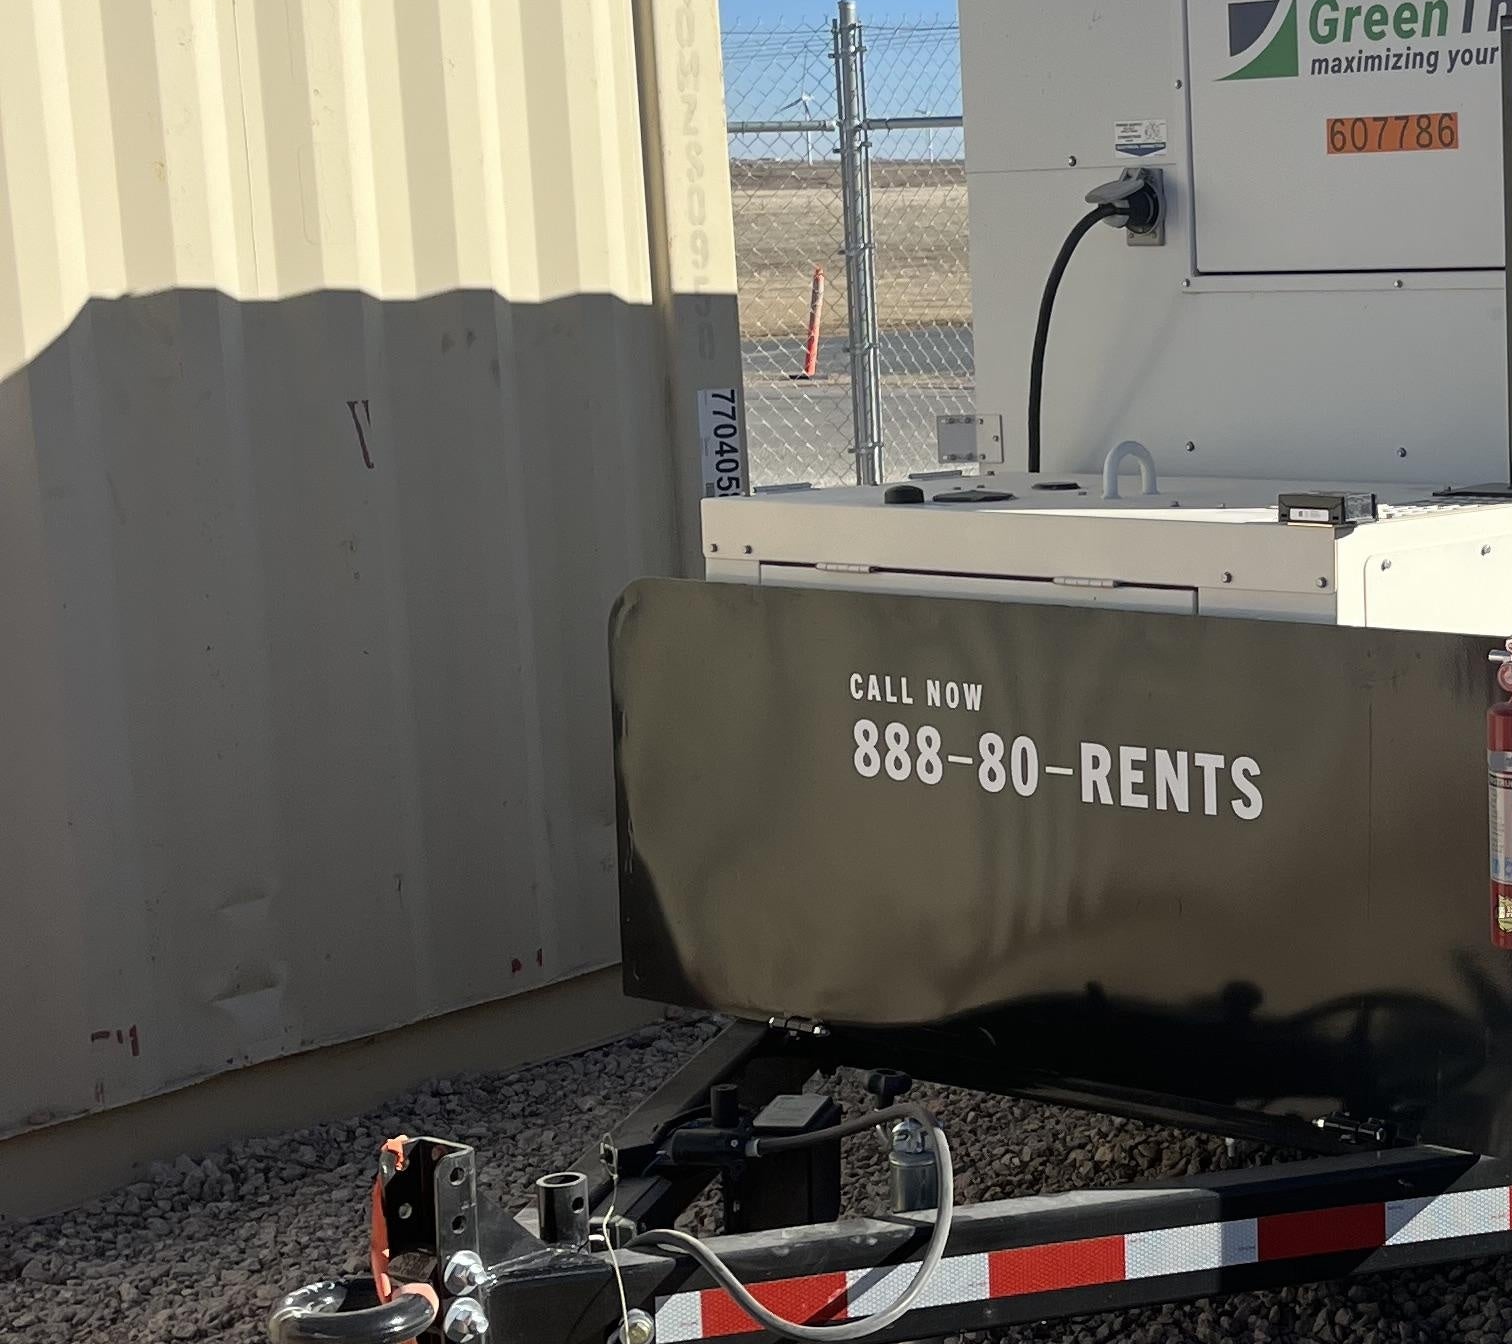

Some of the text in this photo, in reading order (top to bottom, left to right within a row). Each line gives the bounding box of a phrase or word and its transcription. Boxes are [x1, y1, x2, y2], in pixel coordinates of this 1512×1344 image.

[1310, 45, 1500, 76] maximizing your
[1329, 113, 1456, 153] 607786
[850, 673, 983, 711] CALL NOW
[853, 719, 1263, 820] 888-80-RENTS
